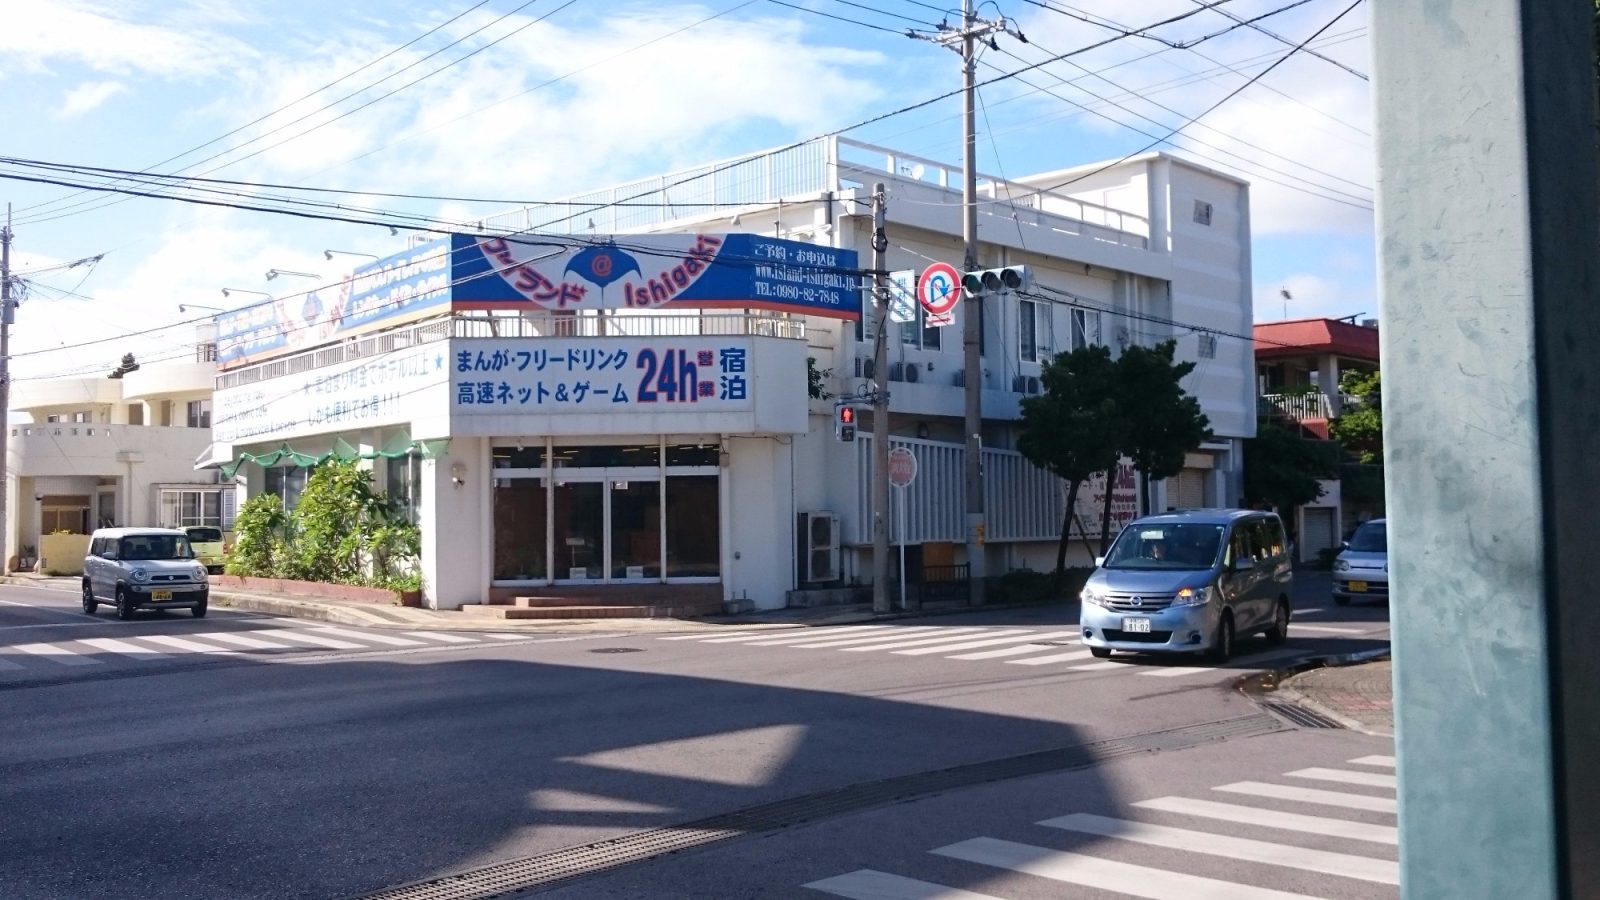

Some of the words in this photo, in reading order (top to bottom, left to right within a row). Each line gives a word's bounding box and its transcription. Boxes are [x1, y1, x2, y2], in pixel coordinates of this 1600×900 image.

[623, 233, 722, 307] Ishigaki
[754, 263, 856, 292] www.island-ishigaki.jp
[755, 281, 840, 305] TEL:0980-82-7848
[456, 349, 629, 372] まんが・フリードリンク
[636, 347, 698, 403] 24h
[697, 350, 715, 398] 営業
[719, 347, 747, 401] 宿泊
